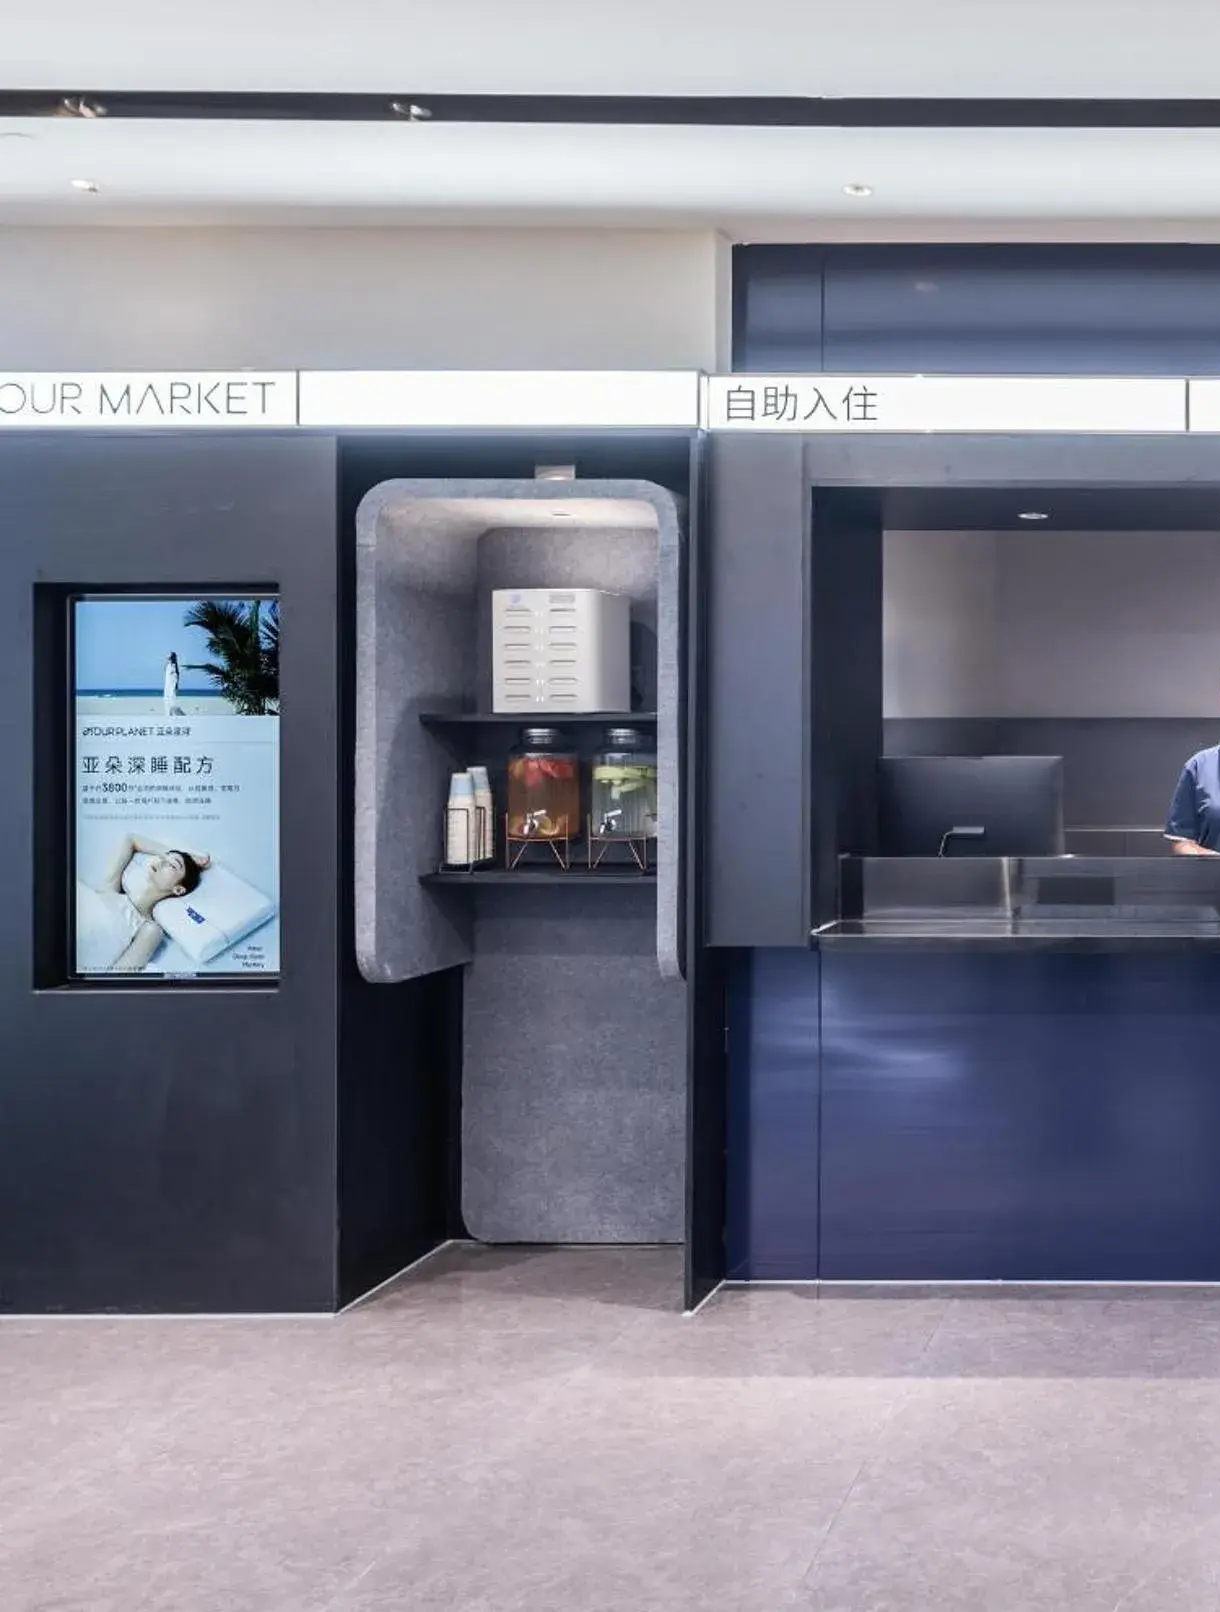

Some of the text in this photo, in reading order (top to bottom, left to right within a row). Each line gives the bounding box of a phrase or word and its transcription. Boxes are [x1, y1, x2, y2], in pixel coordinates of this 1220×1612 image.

[0, 381, 276, 415] OUR MARKET
[726, 385, 879, 422] 自助入住
[81, 755, 214, 775] 亚朵深睡配方
